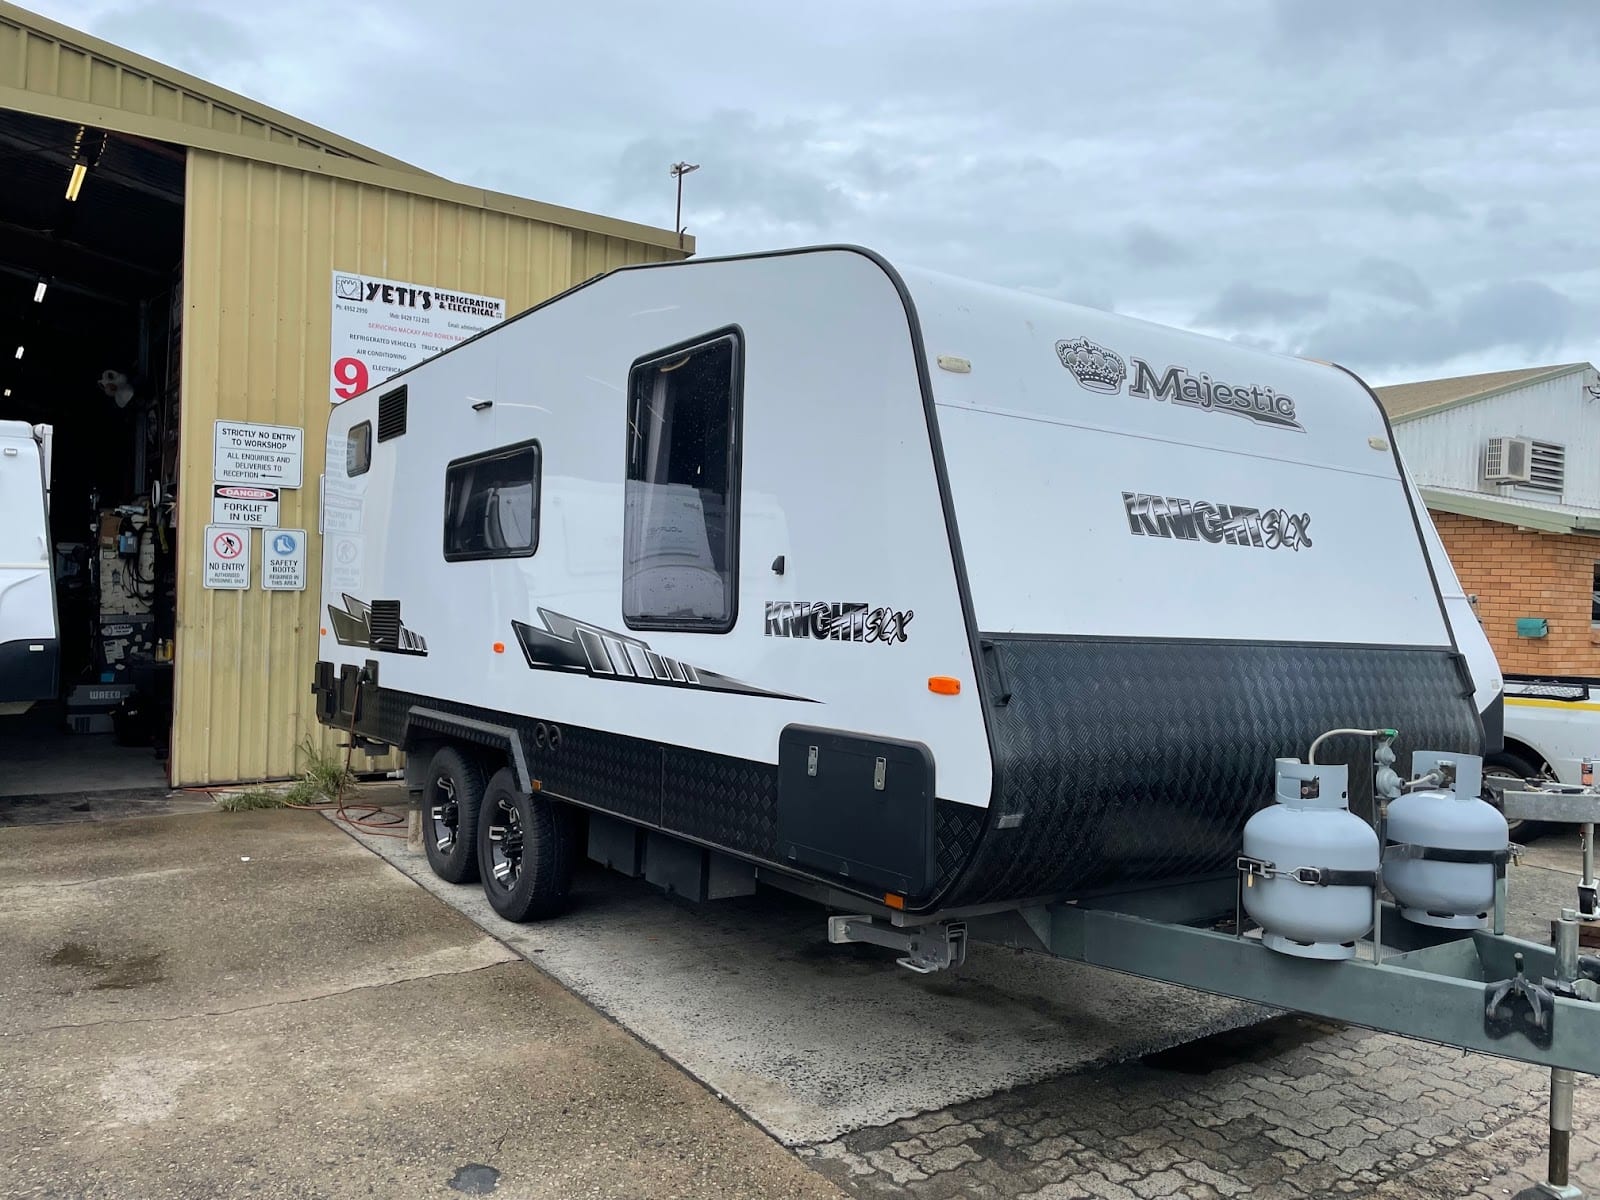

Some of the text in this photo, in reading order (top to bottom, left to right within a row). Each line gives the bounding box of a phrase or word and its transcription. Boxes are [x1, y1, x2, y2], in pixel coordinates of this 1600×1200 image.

[366, 282, 431, 309] YETI'S
[434, 292, 500, 310] REFRIGERATION
[448, 303, 495, 317] ELECTRICAL
[368, 322, 397, 332] SERVICING
[398, 326, 420, 335] MACKAY
[434, 332, 453, 341] BOWEN
[350, 334, 389, 345] REFRIGERATED
[391, 339, 416, 348] VEHICLES
[368, 350, 407, 360] CONDITIONING
[372, 364, 403, 372] ELECTRICA
[334, 357, 368, 400] 9
[1130, 356, 1296, 420] Majestic
[222, 428, 256, 438] STRICTLY
[272, 432, 295, 441] ENTRY
[232, 438, 287, 450] TO WORKSHOP
[241, 453, 274, 462] ENQUIRIES
[235, 462, 282, 472] DELIVERIES TO
[223, 470, 258, 478] RECEPTION
[225, 489, 267, 498] DANGER
[223, 503, 269, 512] FORKLIFT
[243, 513, 262, 521] USE
[209, 562, 245, 571] NO ENTRY
